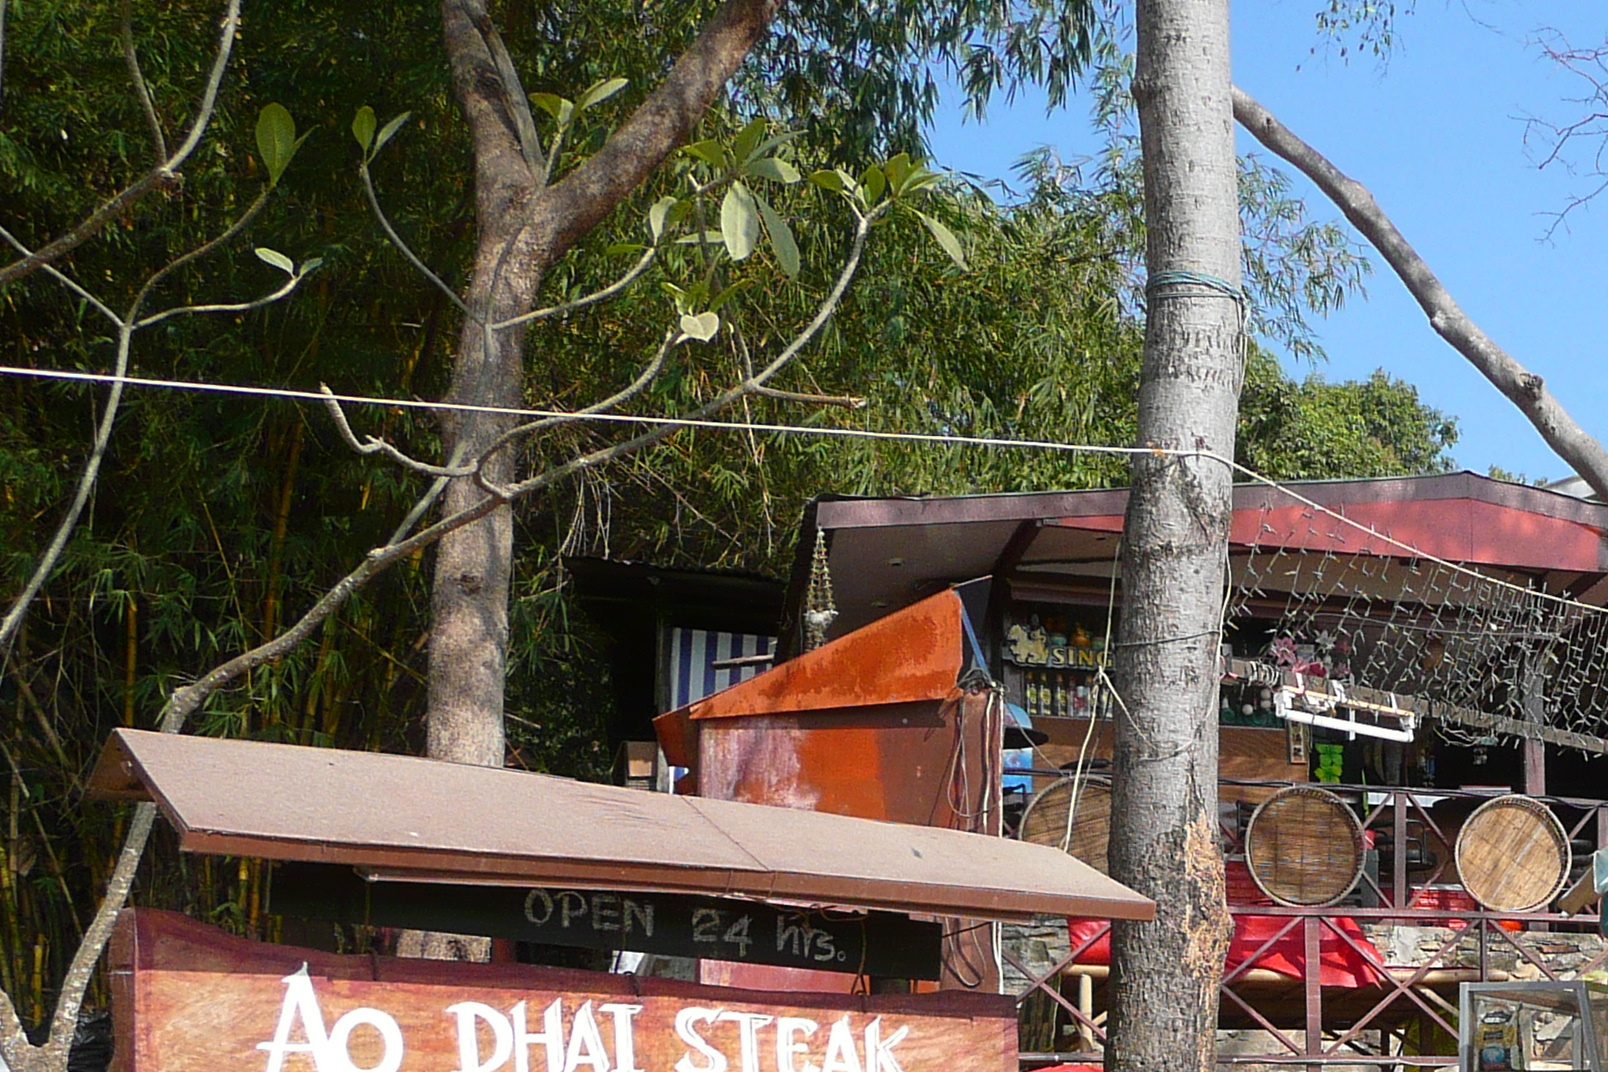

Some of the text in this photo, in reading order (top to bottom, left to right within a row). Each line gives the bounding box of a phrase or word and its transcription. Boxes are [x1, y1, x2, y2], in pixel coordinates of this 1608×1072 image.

[524, 888, 846, 962] OPEN 24 hrs.
